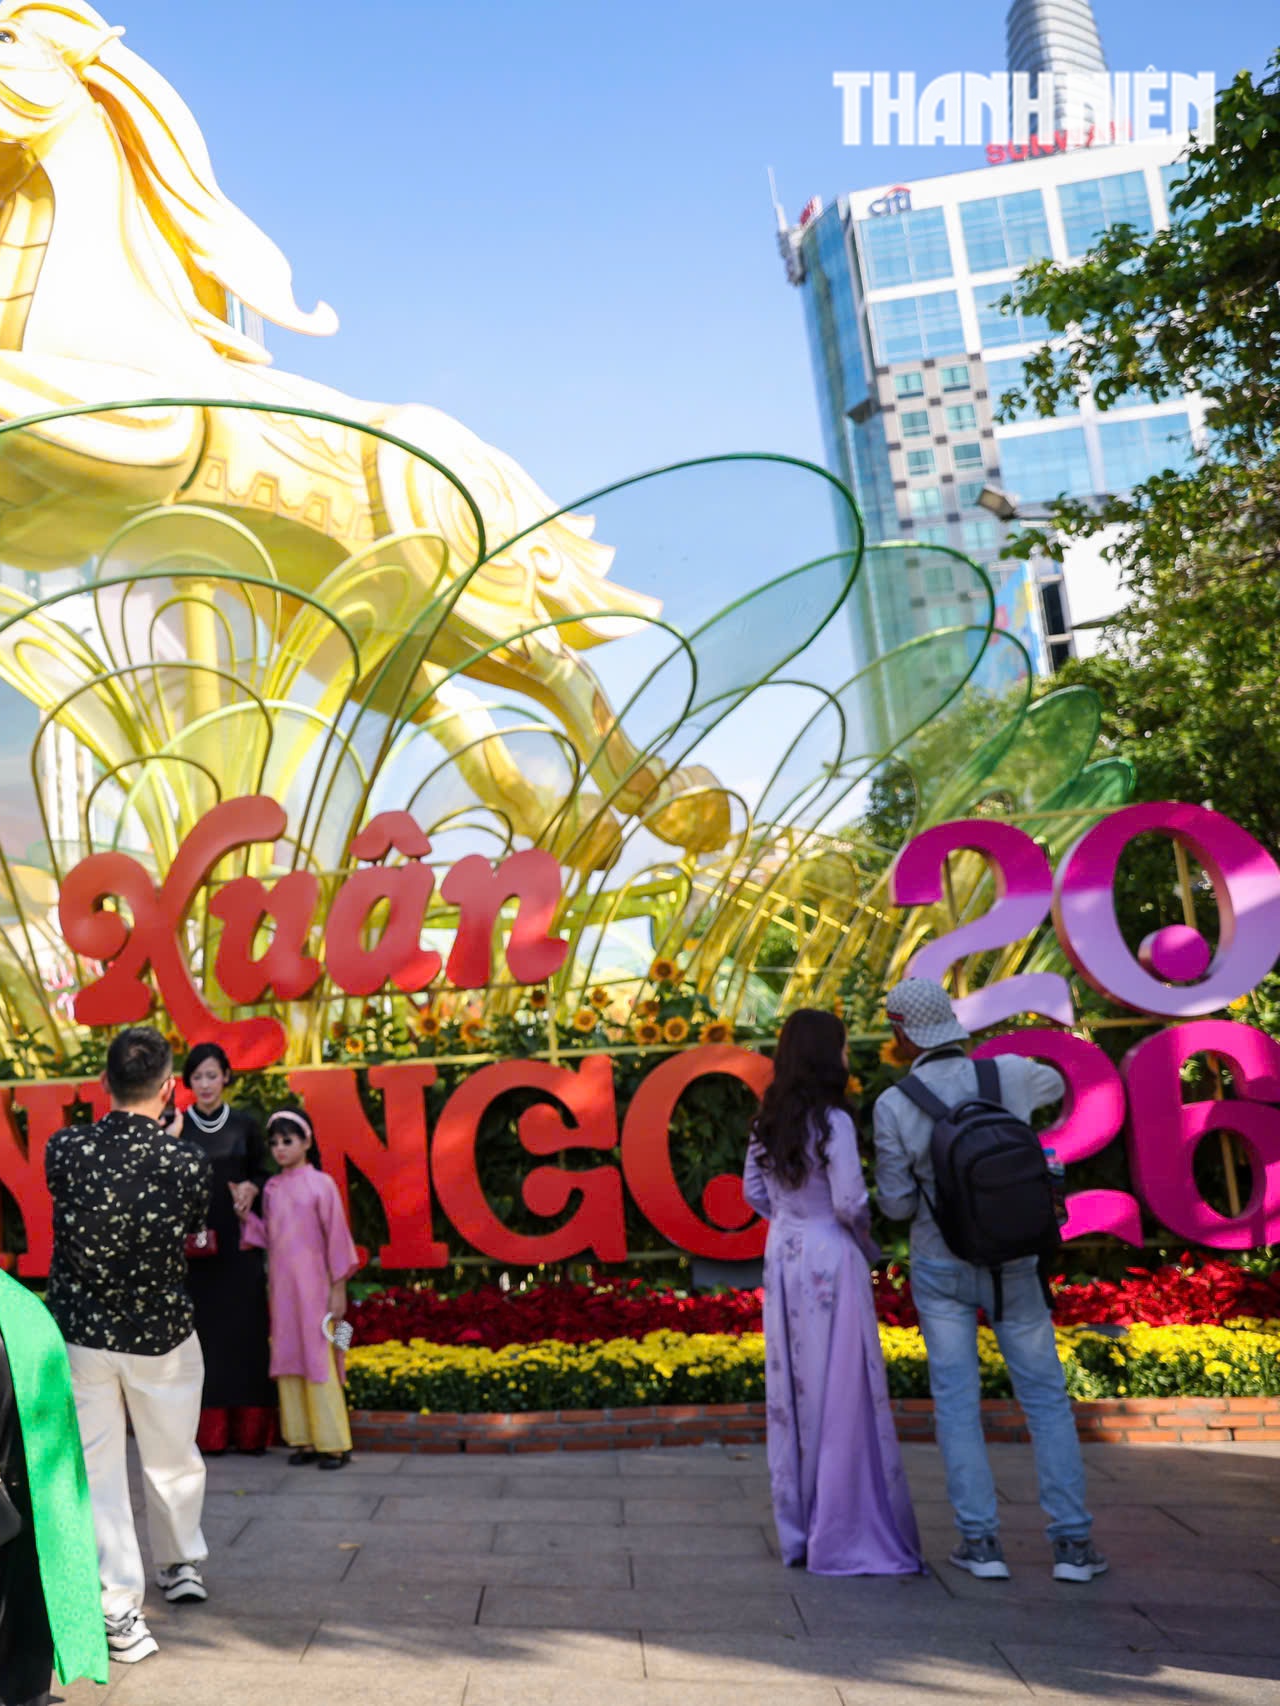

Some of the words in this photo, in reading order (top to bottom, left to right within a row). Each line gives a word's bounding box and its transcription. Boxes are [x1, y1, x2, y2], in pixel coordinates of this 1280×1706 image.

[58, 794, 570, 1071] Xuân
[889, 800, 1280, 1033] 20
[969, 1020, 1280, 1250] 26
